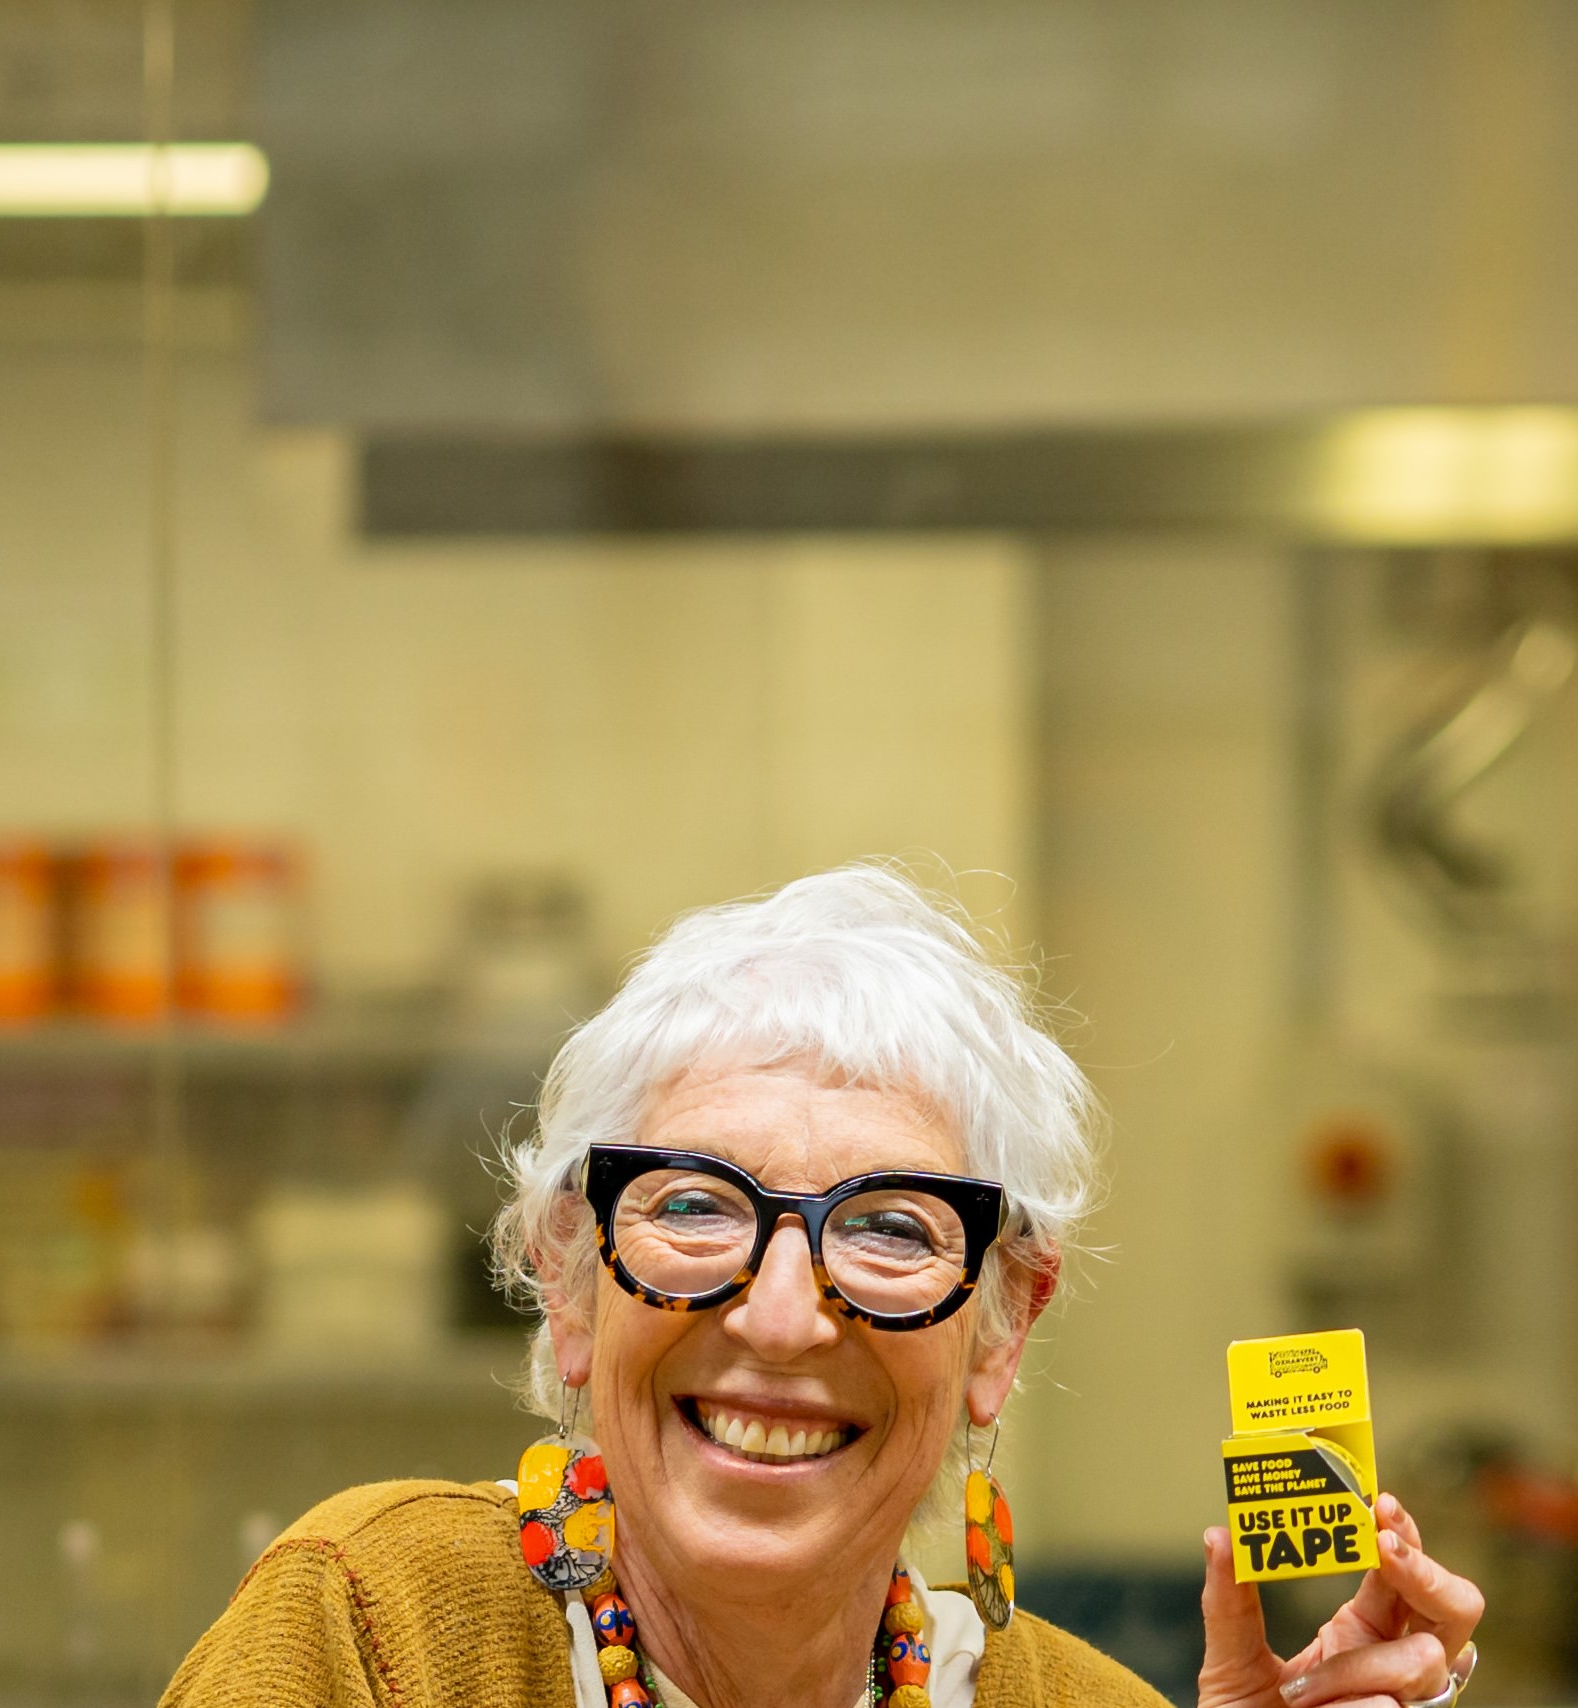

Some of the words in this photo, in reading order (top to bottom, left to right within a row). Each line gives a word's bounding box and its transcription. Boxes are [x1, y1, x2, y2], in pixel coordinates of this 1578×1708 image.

[1246, 1396, 1290, 1409] MAKING
[1293, 1395, 1304, 1404] IT
[1307, 1391, 1334, 1402] EASY
[1338, 1389, 1353, 1399] TO
[1250, 1408, 1287, 1420] WASTE
[1291, 1405, 1315, 1415] LESS
[1319, 1401, 1350, 1412] FOOD
[1232, 1461, 1259, 1474] SAVE
[1261, 1458, 1293, 1470] FOOD
[1233, 1472, 1260, 1485] SAVE
[1262, 1468, 1302, 1482] MONEY
[1234, 1484, 1262, 1497] SAVE
[1264, 1481, 1285, 1494] THE
[1287, 1477, 1327, 1491] PLANET
[1238, 1508, 1284, 1532] USE
[1290, 1506, 1314, 1526] IT
[1319, 1503, 1352, 1524] UP
[1239, 1524, 1361, 1572] TAPE
